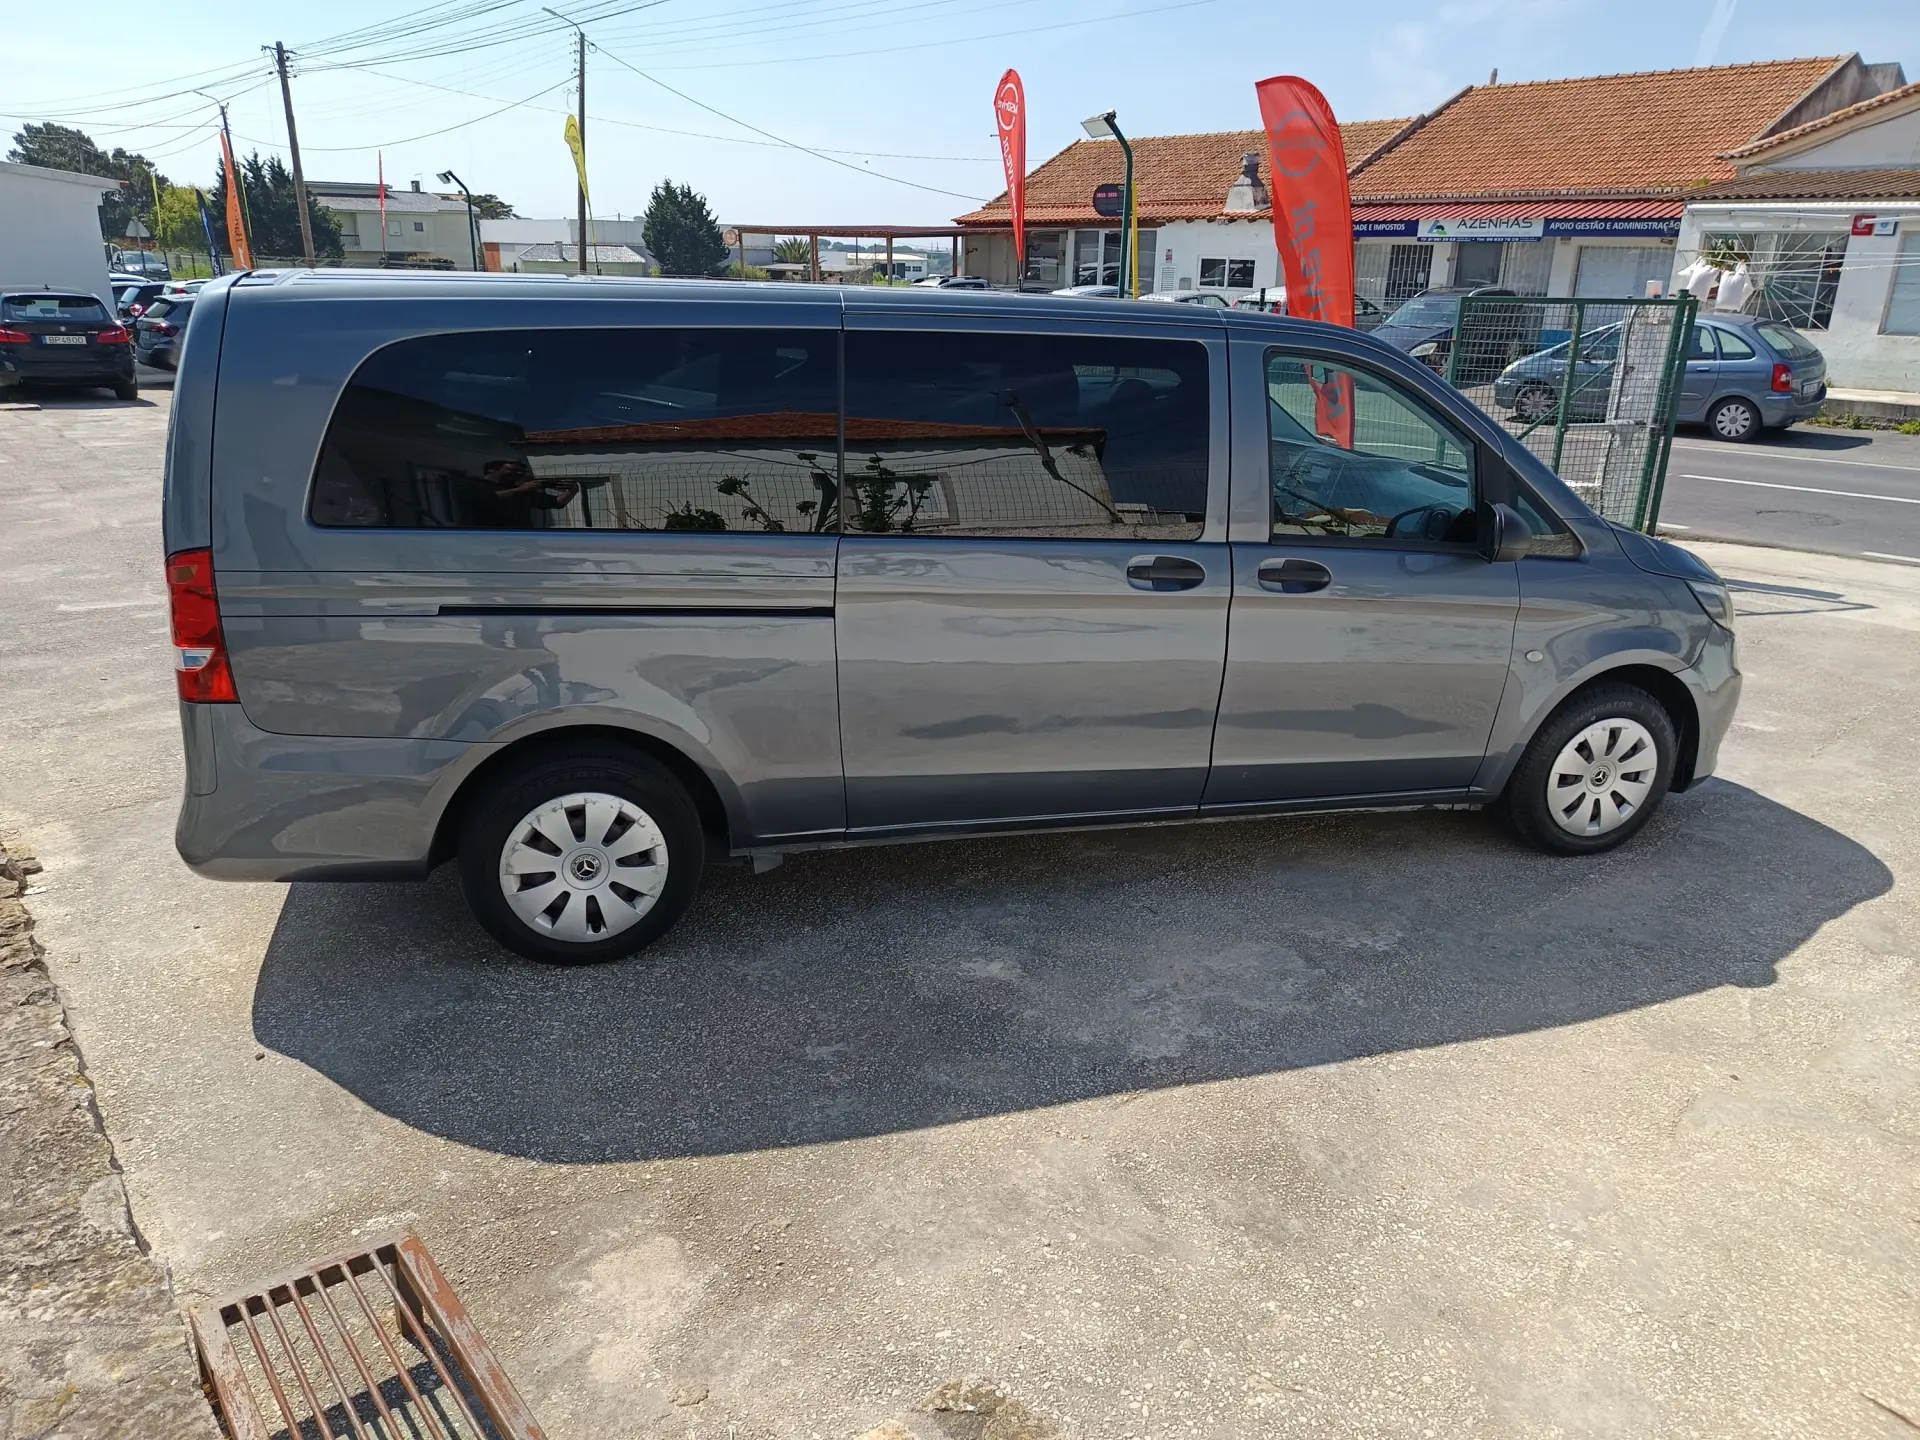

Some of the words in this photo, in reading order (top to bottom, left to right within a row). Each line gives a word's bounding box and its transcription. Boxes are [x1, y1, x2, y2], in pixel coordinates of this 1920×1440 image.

[1368, 223, 1373, 231] E
[1373, 223, 1406, 231] IMPOSTOS
[1457, 217, 1533, 229] AZENHAS
[1549, 222, 1574, 230] APOIO
[1575, 220, 1605, 230] GESTÃO
[1606, 222, 1612, 230] E
